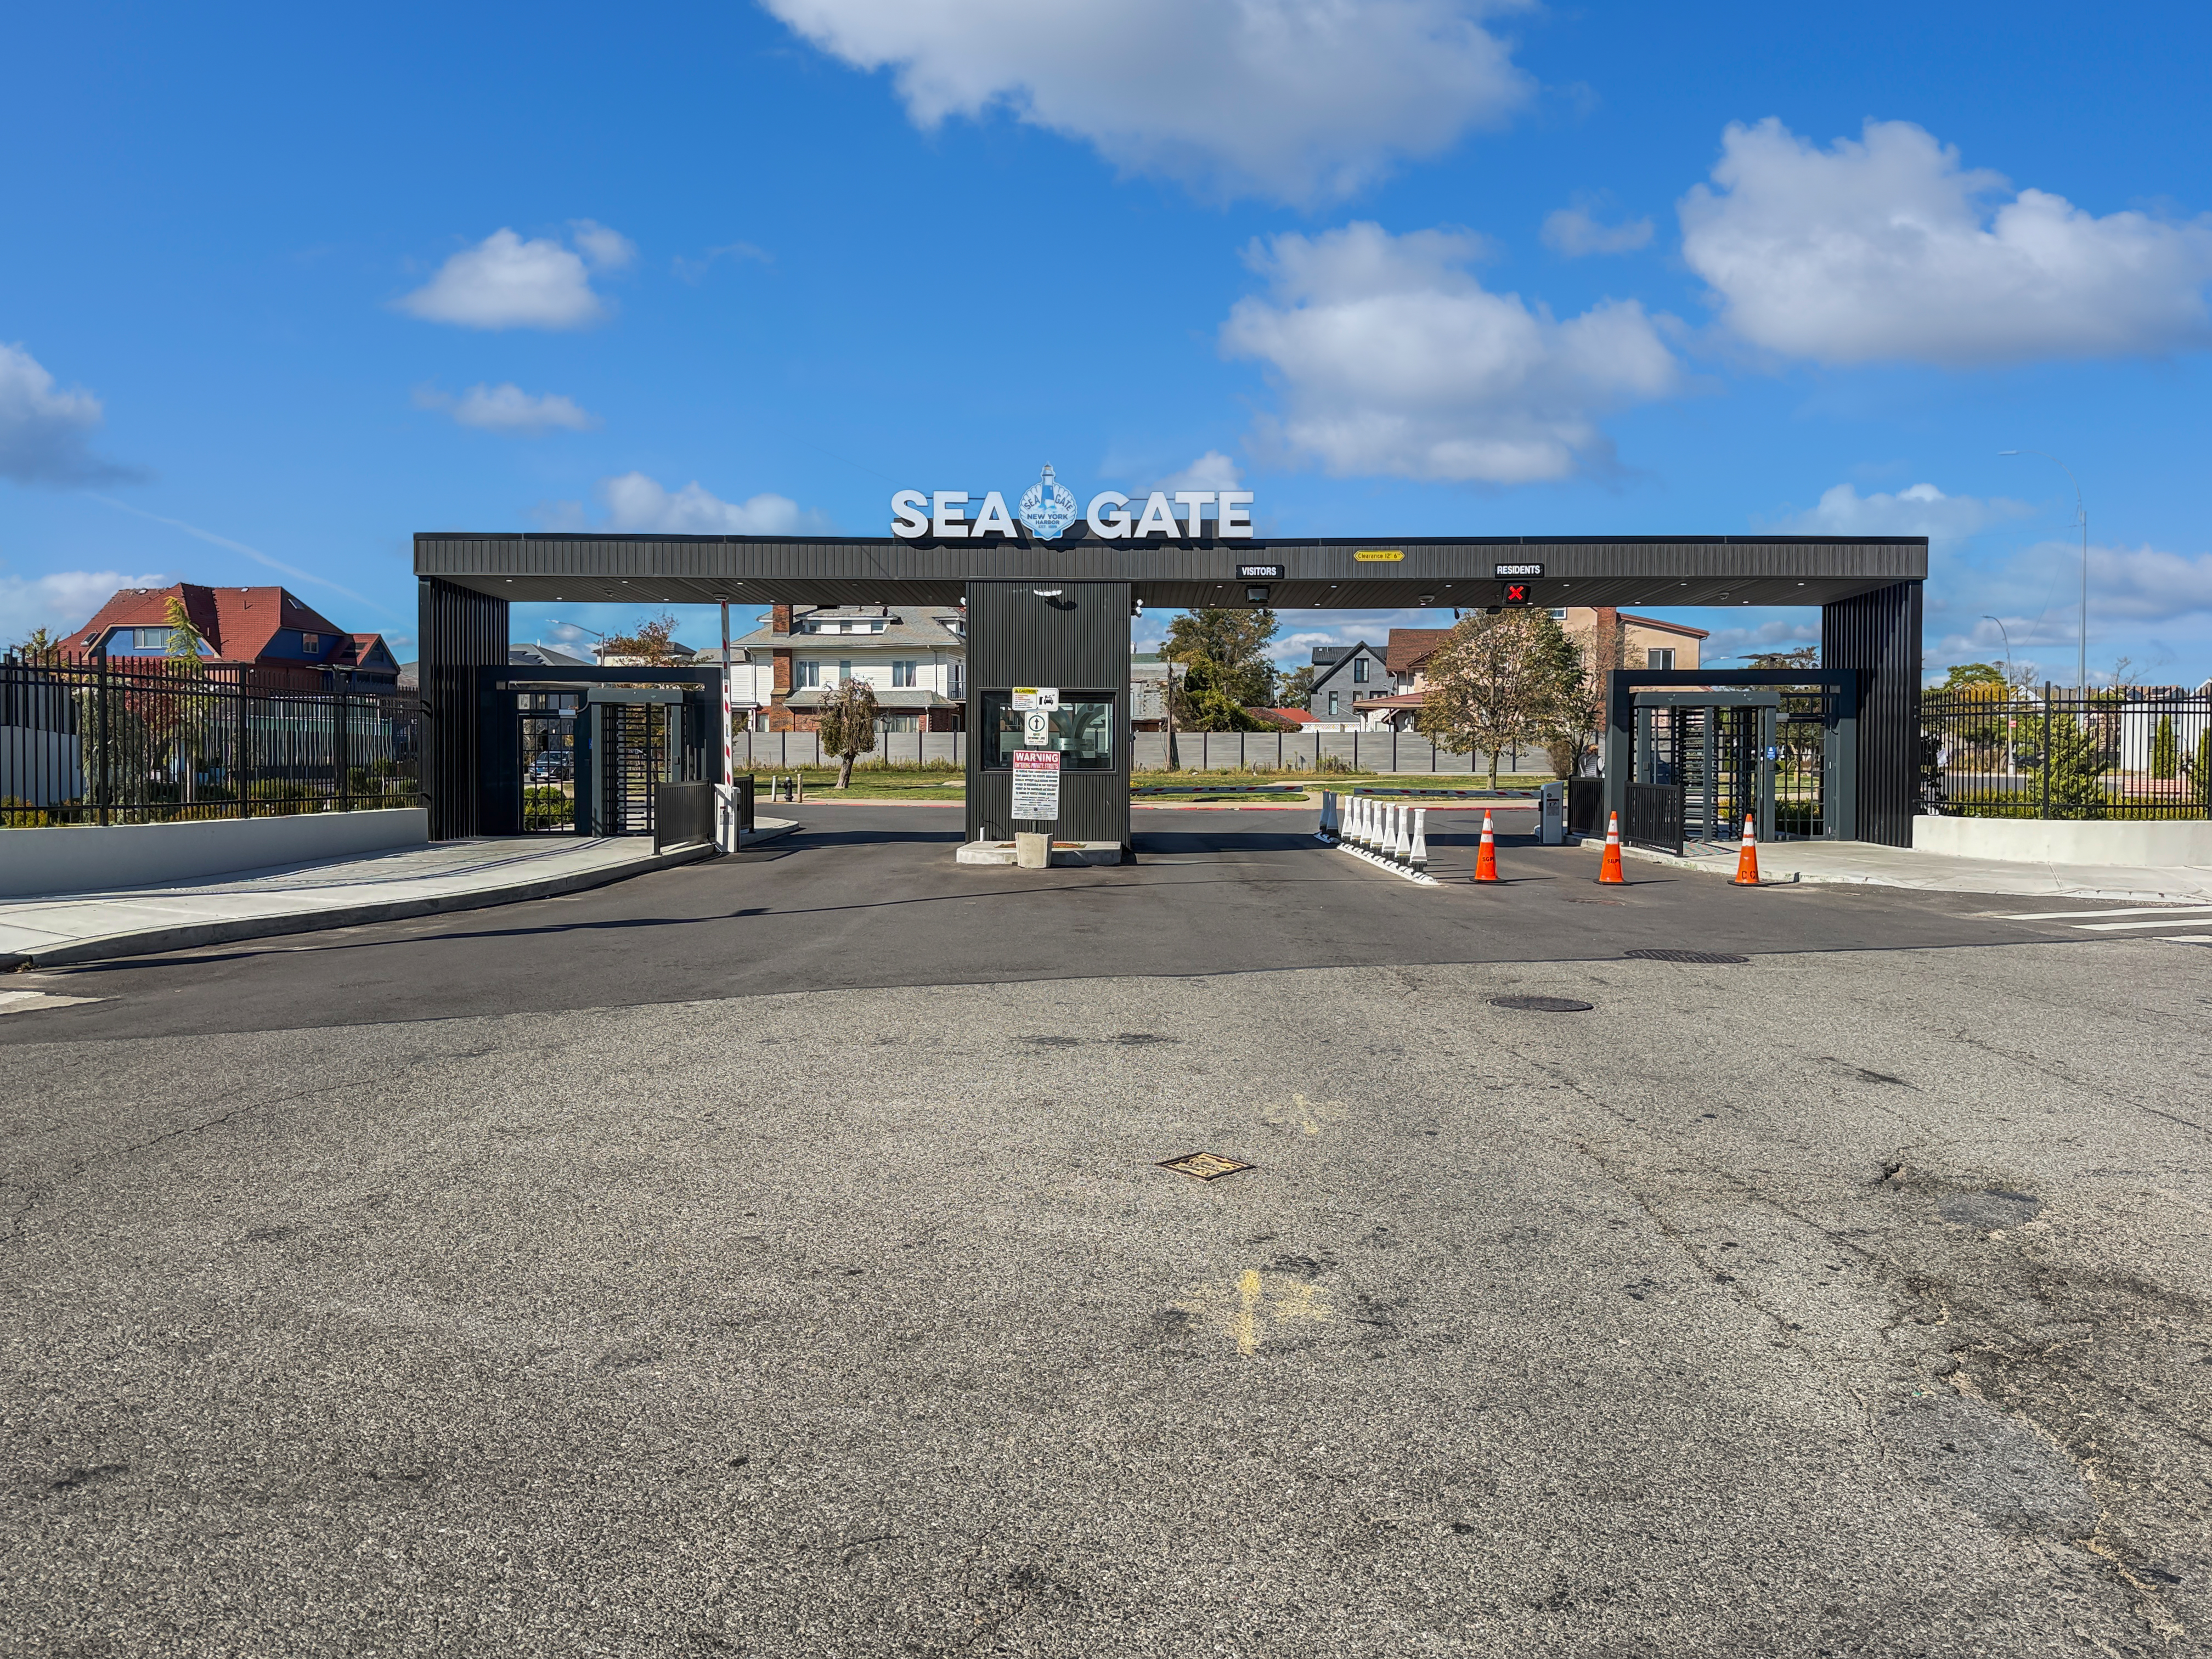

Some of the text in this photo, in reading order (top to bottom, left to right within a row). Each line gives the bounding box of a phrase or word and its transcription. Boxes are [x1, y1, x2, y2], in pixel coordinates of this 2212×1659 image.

[1024, 494, 1073, 511] SEA GATE
[890, 489, 1254, 539] SEA GATE
[1242, 567, 1277, 575] VISITORS
[1497, 565, 1541, 574] RESIDENTS
[1015, 752, 1058, 763] WARNING
